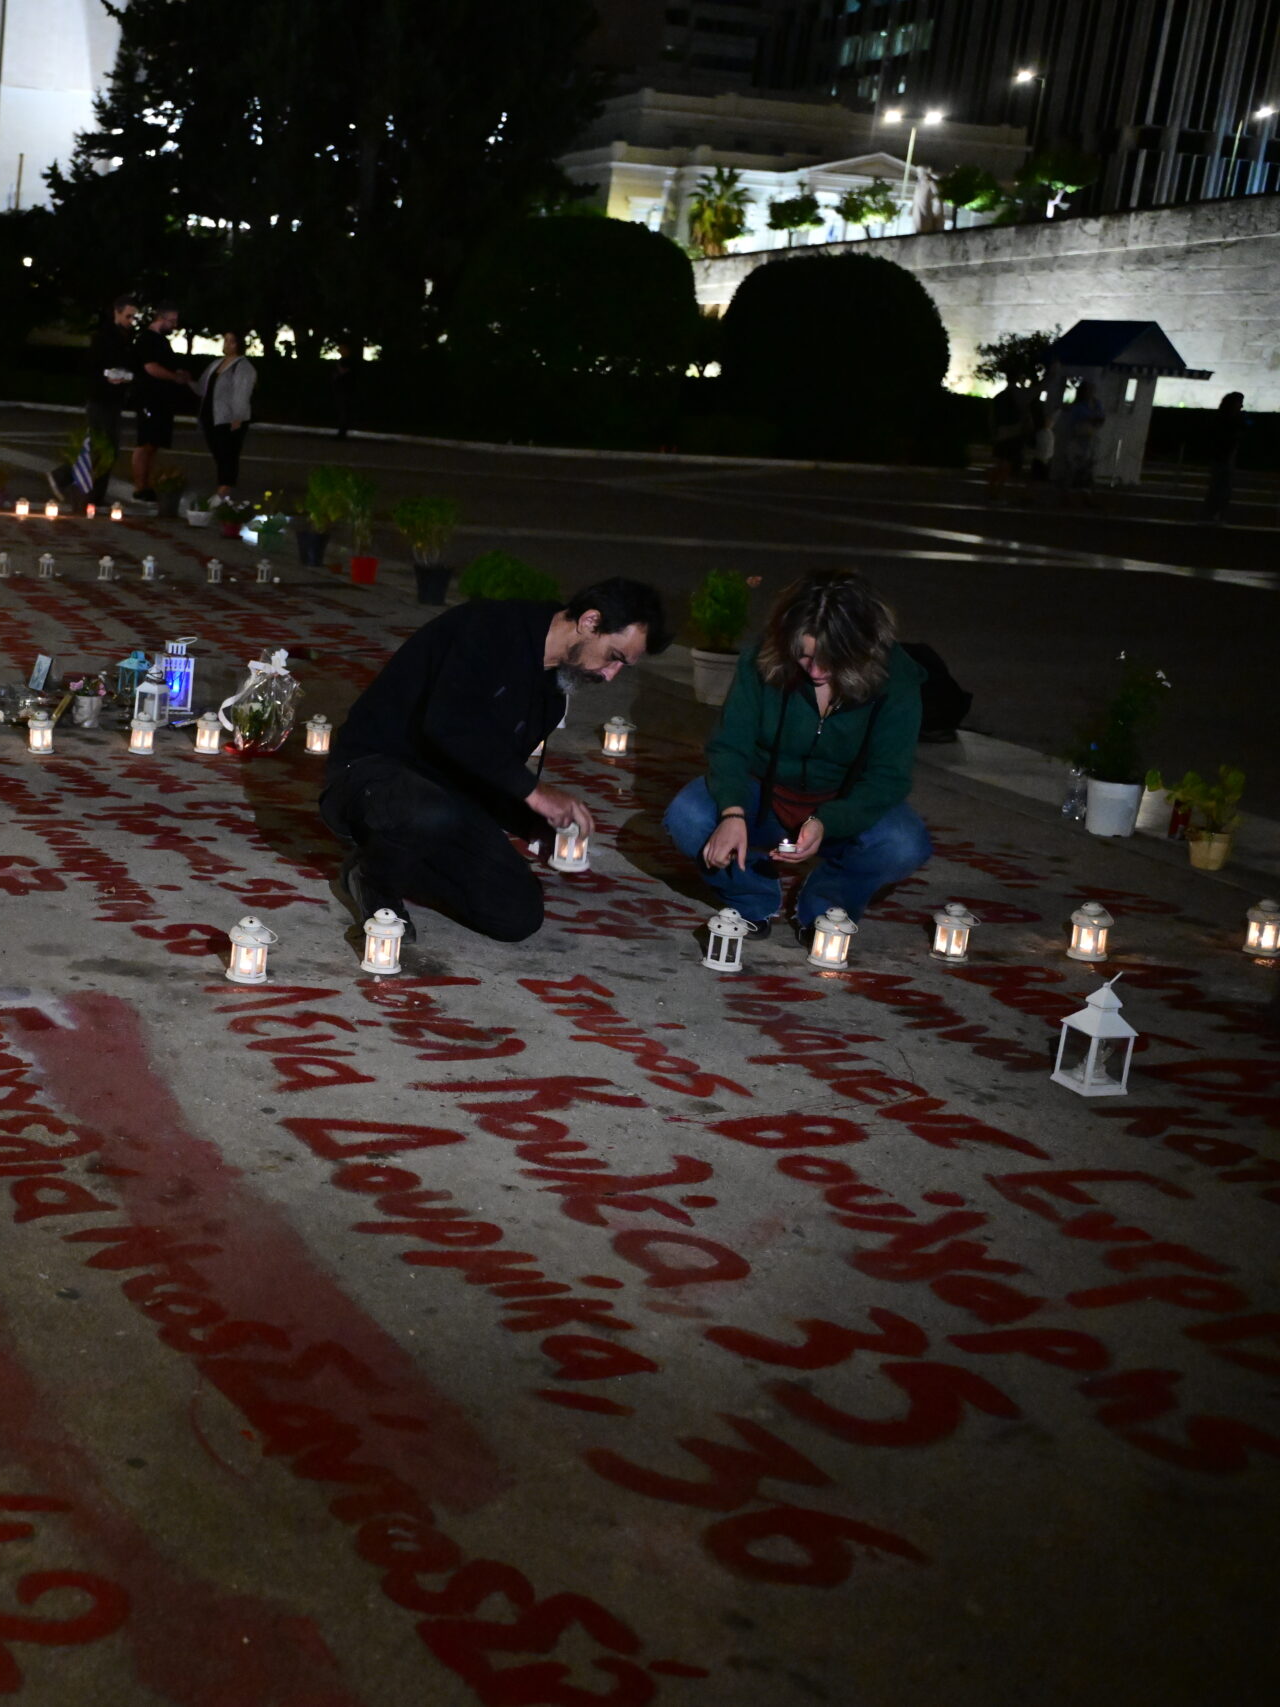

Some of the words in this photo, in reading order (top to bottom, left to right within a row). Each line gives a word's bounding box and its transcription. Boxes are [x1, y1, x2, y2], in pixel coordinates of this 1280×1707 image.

[219, 878, 328, 909] 56
[519, 974, 753, 1098] Σπύρος
[205, 986, 382, 1092] Λένα
[581, 1413, 929, 1588] 36
[704, 1307, 1021, 1449] 35
